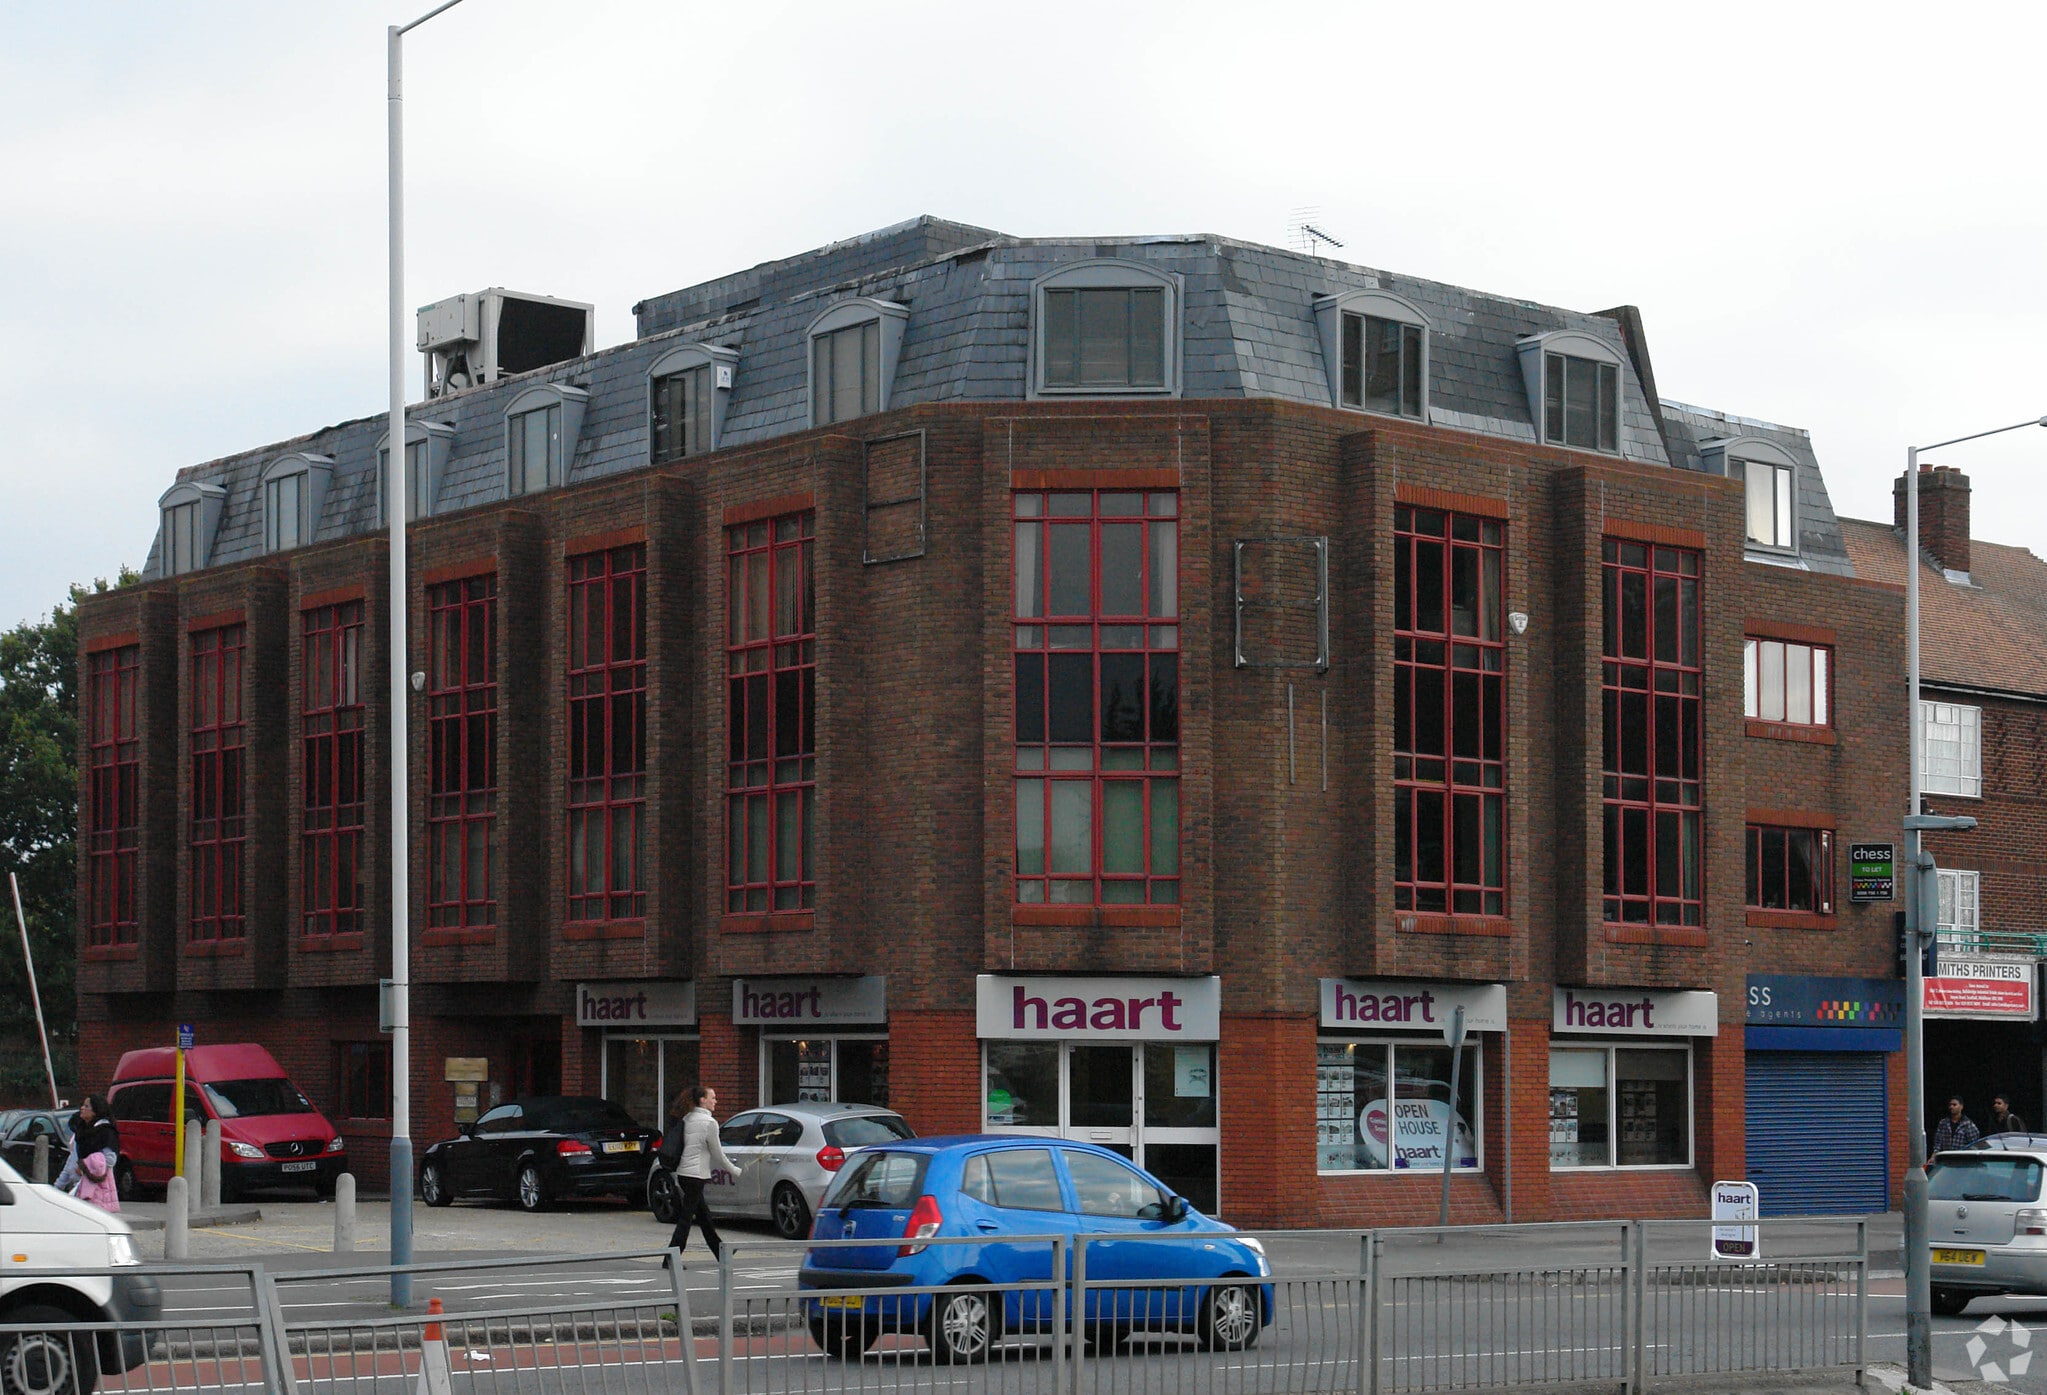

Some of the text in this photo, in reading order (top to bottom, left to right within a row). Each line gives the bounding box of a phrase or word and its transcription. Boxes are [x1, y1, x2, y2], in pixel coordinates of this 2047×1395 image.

[1853, 847, 1891, 860] chess
[1972, 964, 2022, 980] PRINTERS
[582, 989, 647, 1020] haart
[743, 983, 822, 1019] haart
[1013, 985, 1183, 1031] haart
[1335, 984, 1435, 1023] haart
[1566, 991, 1655, 1029] haart
[1760, 1009, 1802, 1020] agents
[1395, 1104, 1429, 1119] OPEN
[1398, 1121, 1442, 1136] HOUSE
[1395, 1144, 1442, 1160] haart
[1718, 1192, 1752, 1204] haart
[1722, 1242, 1746, 1253] OPEN
